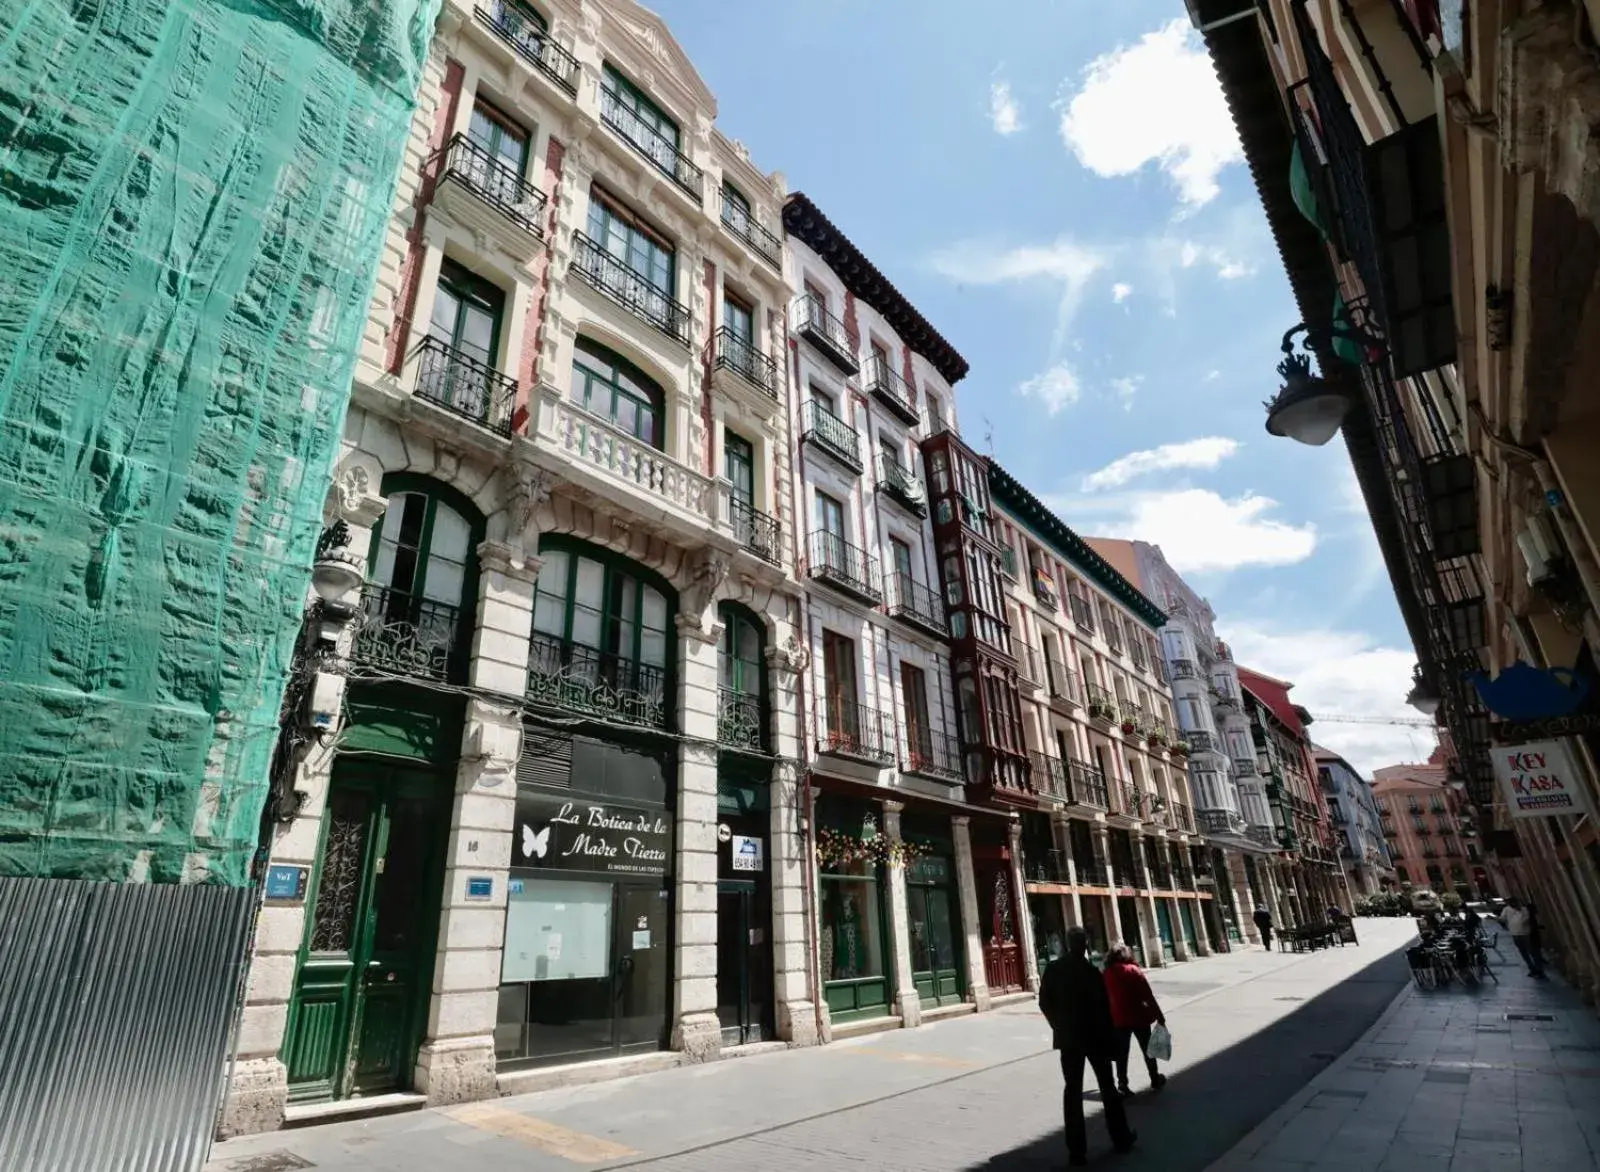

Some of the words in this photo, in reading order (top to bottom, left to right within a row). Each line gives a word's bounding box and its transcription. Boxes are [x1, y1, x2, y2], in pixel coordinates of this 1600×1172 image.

[1507, 752, 1546, 772] KEY
[1510, 774, 1565, 795] KASA
[550, 802, 580, 825] La
[587, 806, 633, 831] Botica
[636, 815, 651, 833] de
[654, 818, 667, 834] la
[562, 833, 618, 857] Madre
[623, 837, 666, 860] Tierra
